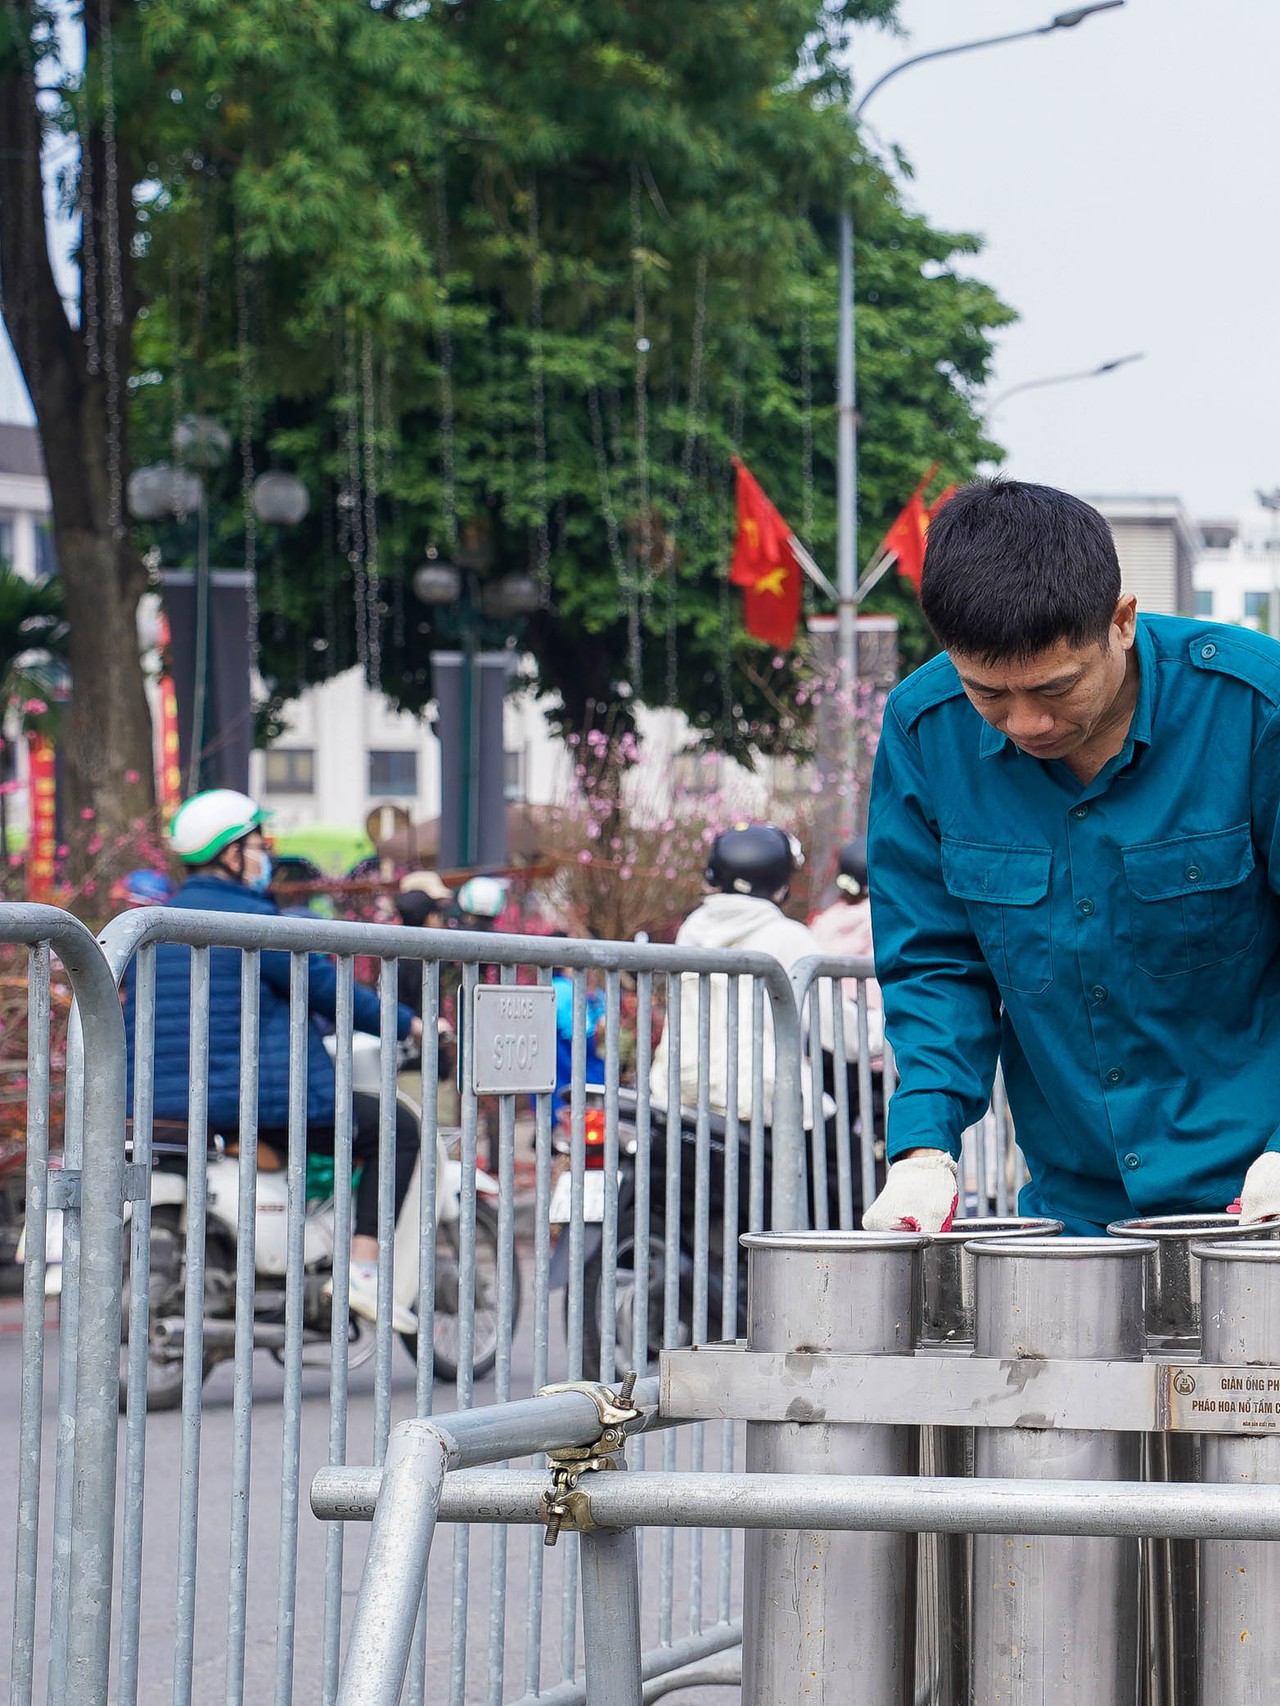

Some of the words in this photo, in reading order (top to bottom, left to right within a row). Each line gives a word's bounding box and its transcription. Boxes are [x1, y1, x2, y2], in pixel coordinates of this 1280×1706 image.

[493, 1034, 539, 1071] STOP
[1192, 1399, 1216, 1412] PHÁO
[1218, 1400, 1236, 1413] HOA
